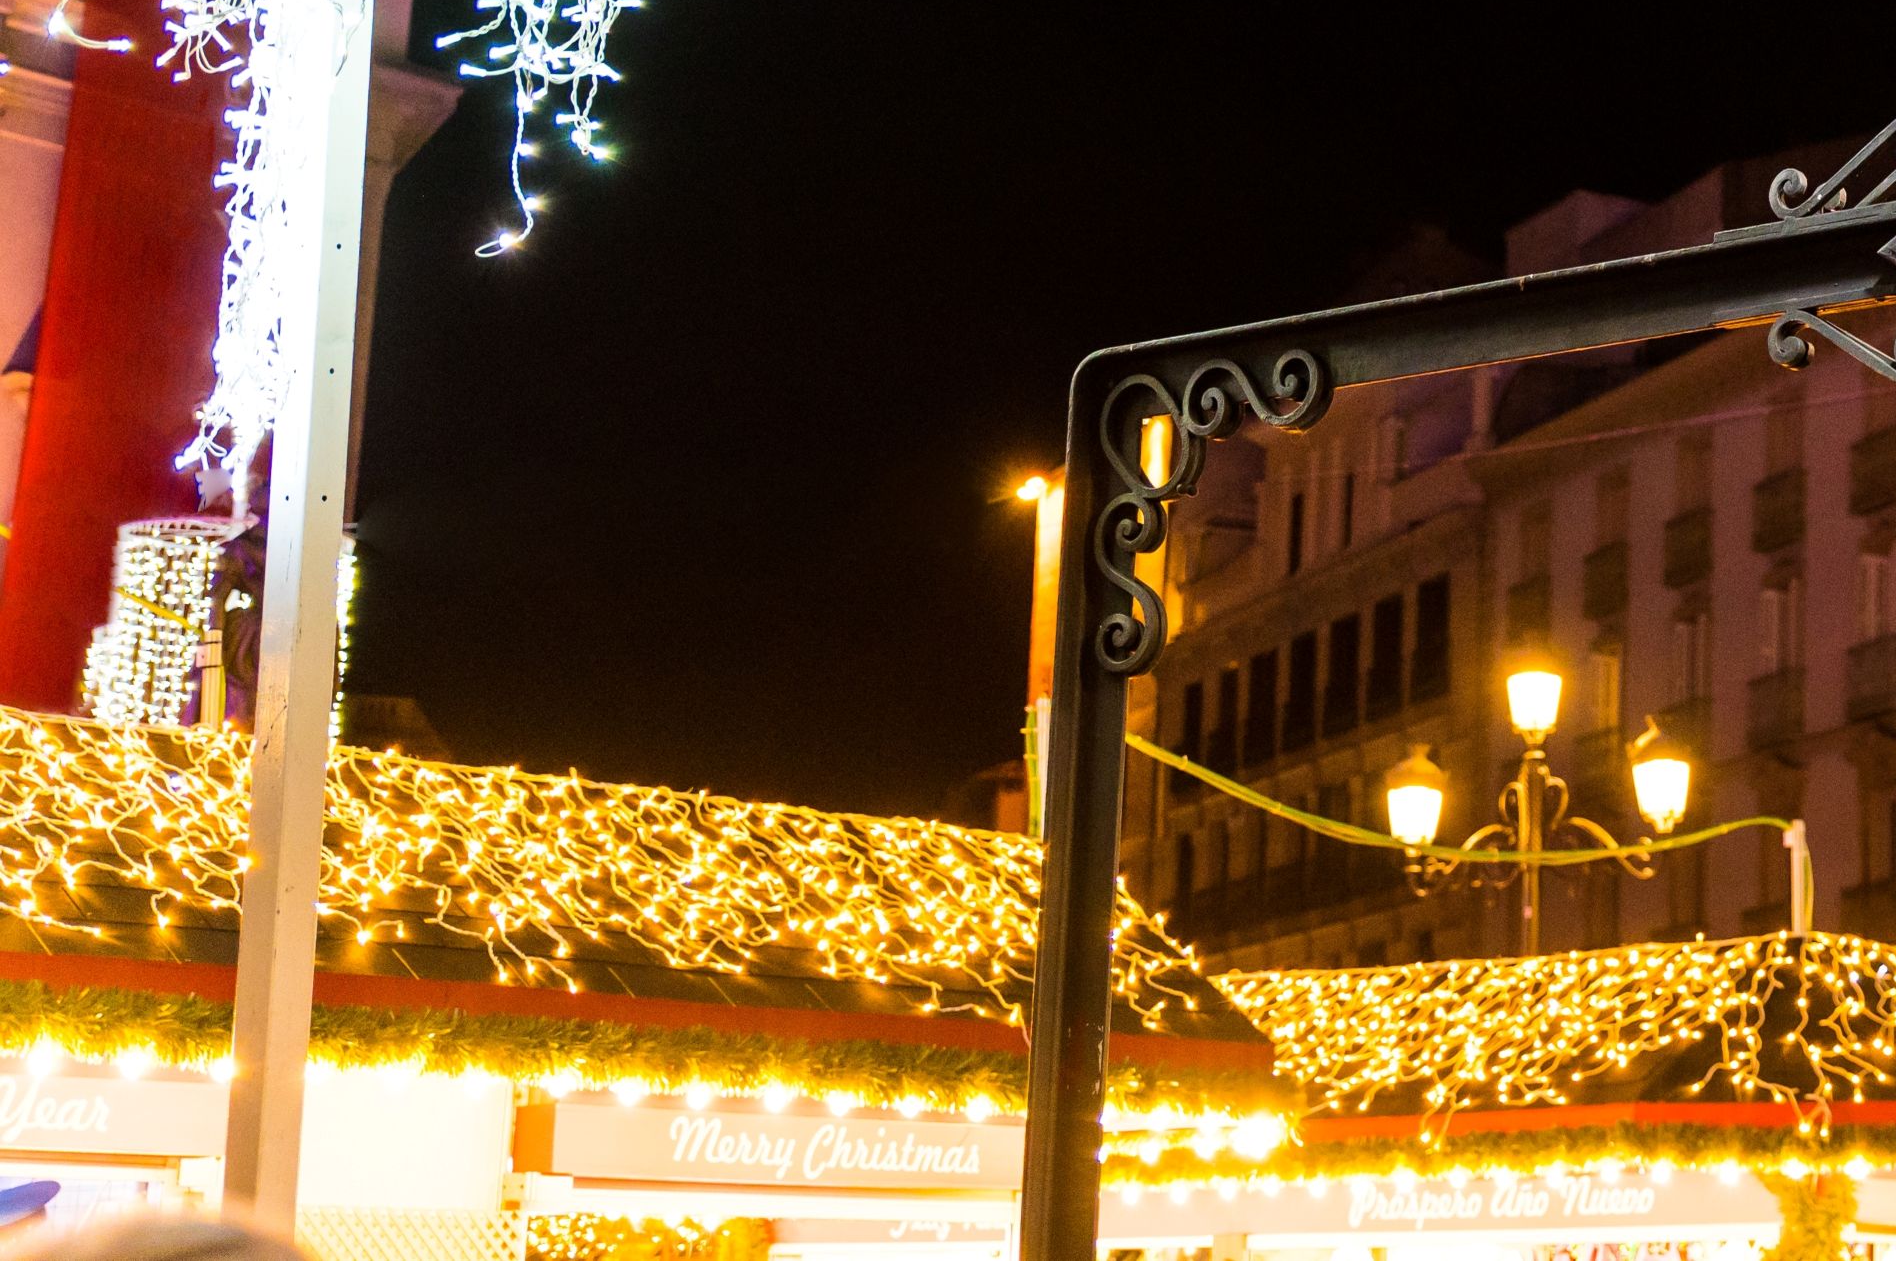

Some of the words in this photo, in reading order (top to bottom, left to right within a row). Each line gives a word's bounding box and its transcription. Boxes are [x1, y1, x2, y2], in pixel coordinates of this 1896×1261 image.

[0, 1076, 110, 1143] Year
[669, 1115, 796, 1180] Merry
[803, 1123, 981, 1181] Christmas
[1560, 1176, 1656, 1217] Nuevo
